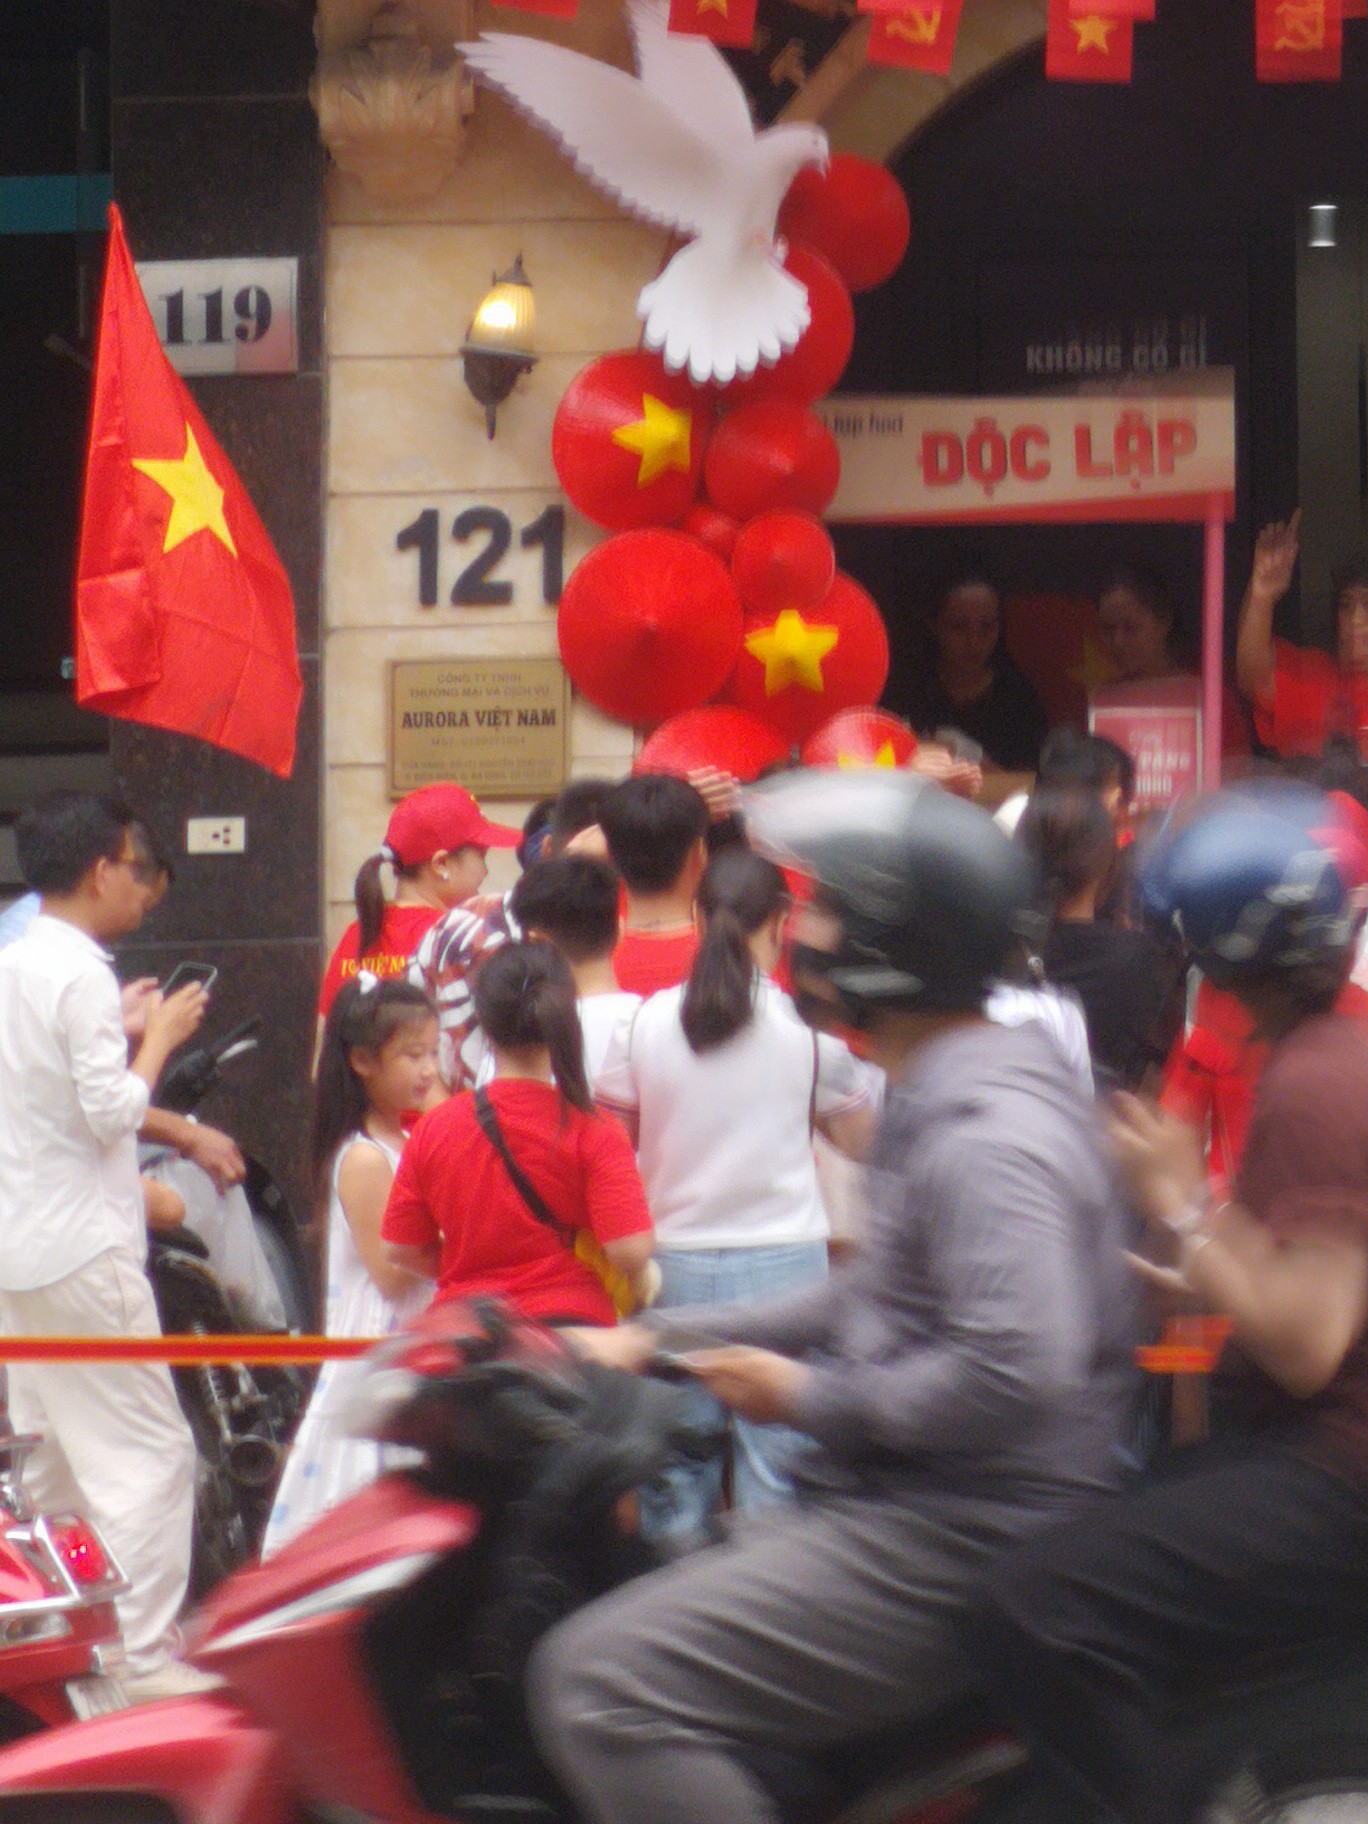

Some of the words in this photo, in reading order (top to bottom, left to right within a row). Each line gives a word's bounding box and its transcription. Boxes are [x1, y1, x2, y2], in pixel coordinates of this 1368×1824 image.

[159, 285, 272, 344] 119
[917, 416, 1050, 497] ĐỘC
[1075, 408, 1197, 492] LẬP
[397, 504, 565, 607] 121
[401, 711, 469, 729] AURORA
[475, 705, 512, 731] VIỆT
[517, 708, 557, 727] NAM
